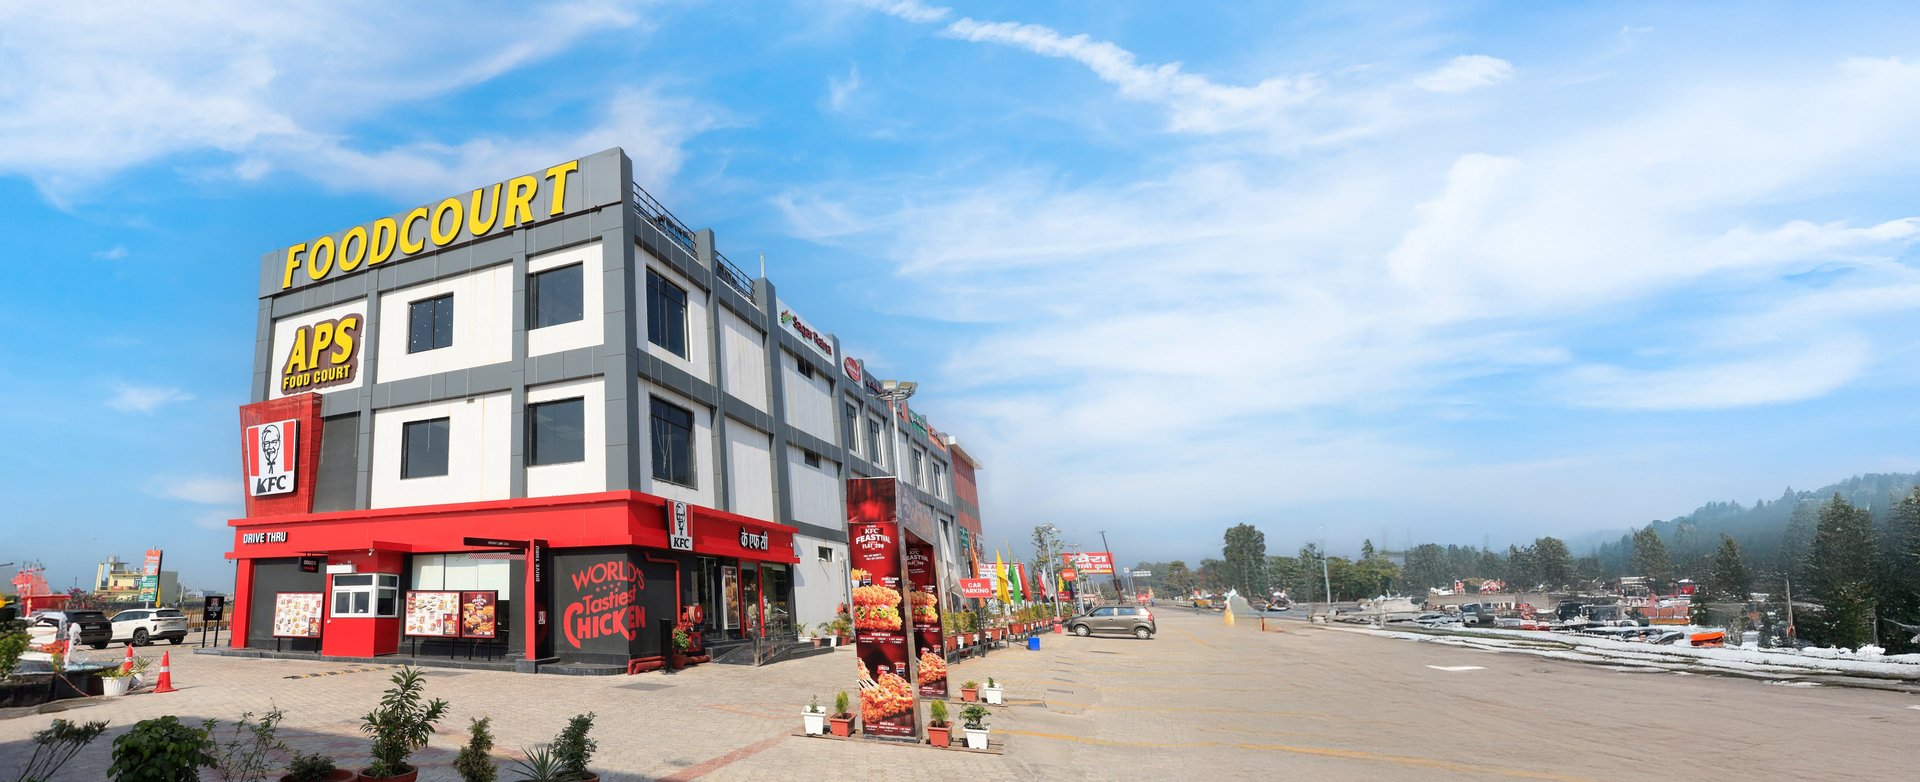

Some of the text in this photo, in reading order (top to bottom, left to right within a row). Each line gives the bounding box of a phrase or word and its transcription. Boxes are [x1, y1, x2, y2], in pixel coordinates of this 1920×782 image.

[281, 159, 579, 290] FOODCOURT
[285, 316, 358, 376] APS
[792, 316, 832, 356] Sagar Ratna
[283, 364, 351, 391] FOOD COURT
[256, 474, 287, 495] KFC
[243, 531, 287, 544] DRIVE THRU
[672, 536, 691, 549] KFC
[571, 560, 645, 591] WORLD'S
[582, 586, 637, 615] Tastiest
[563, 601, 646, 649] CHICKEN
